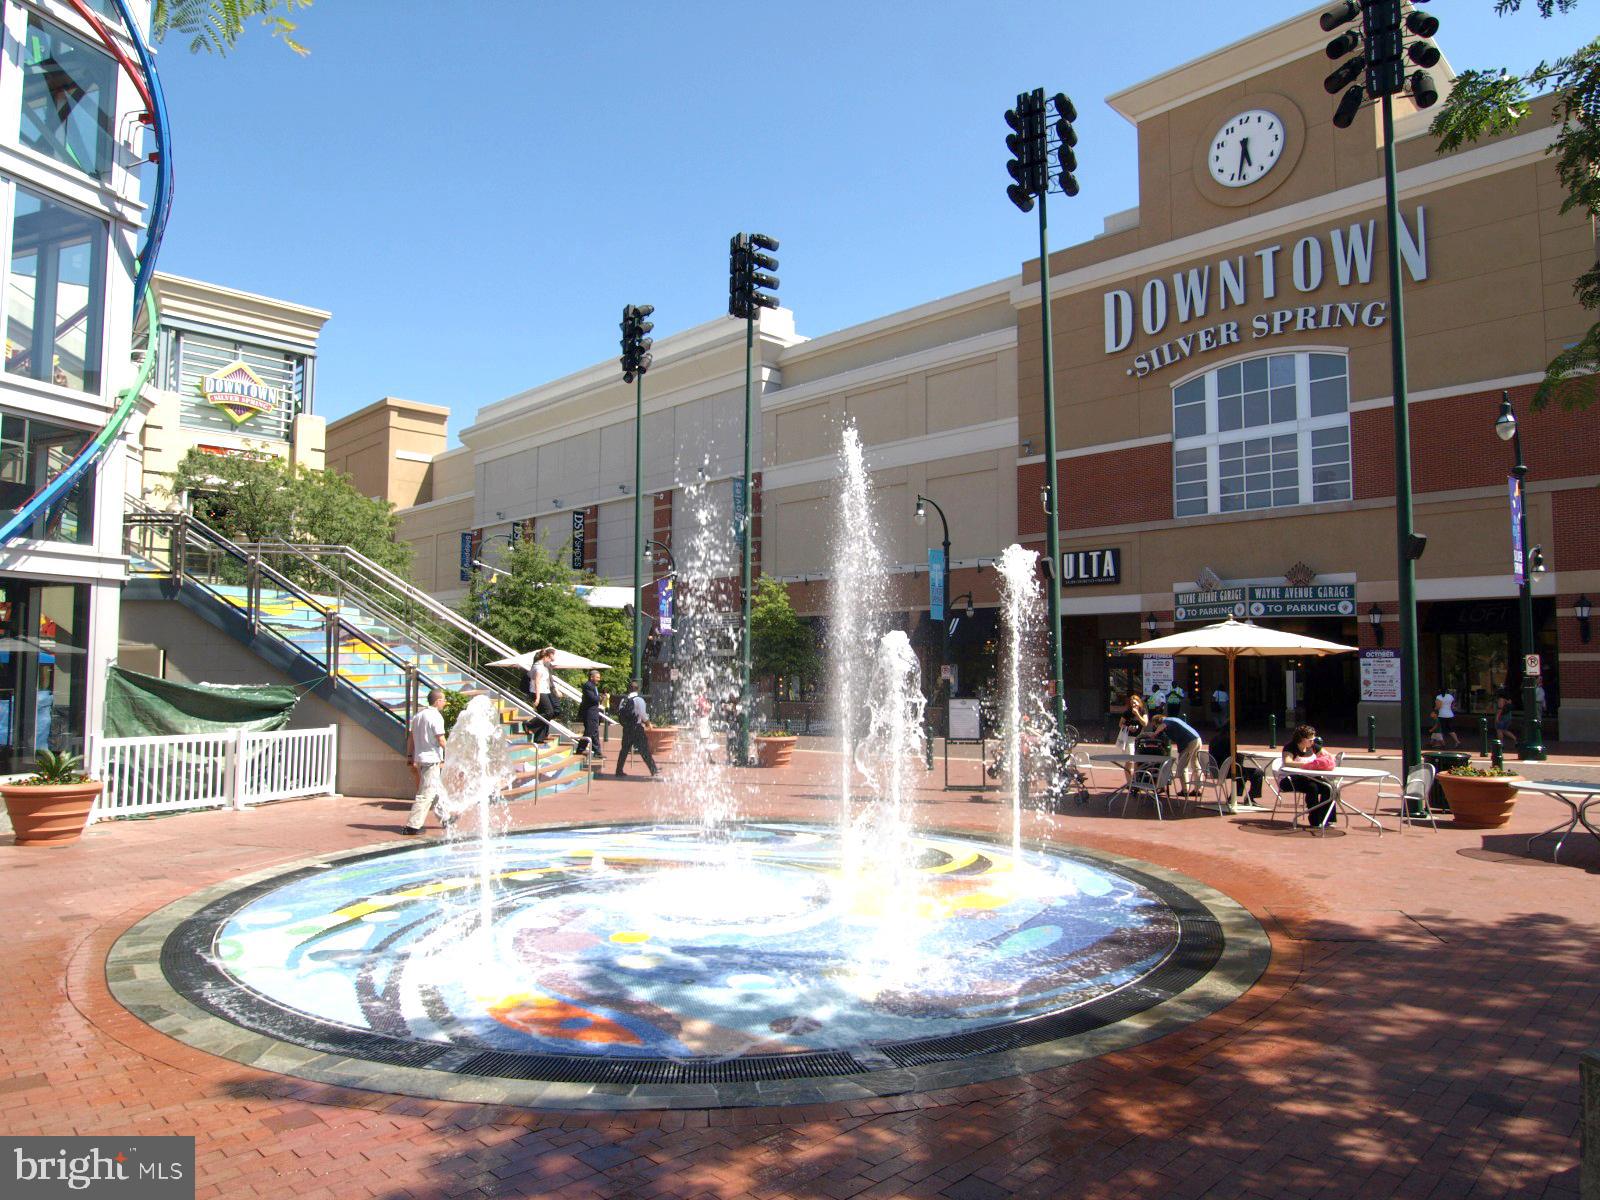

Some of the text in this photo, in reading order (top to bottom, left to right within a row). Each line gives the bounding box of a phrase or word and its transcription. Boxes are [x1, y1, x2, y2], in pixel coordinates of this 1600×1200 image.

[1103, 205, 1429, 354] DOWNTOWN
[1134, 301, 1387, 378] SILVER SPRING
[205, 376, 278, 404] DOWNTOWN
[574, 514, 584, 541] DSW
[1063, 550, 1116, 580] ULTA
[1220, 589, 1242, 600] GARAGE
[1254, 585, 1349, 599] WAYNE AVENUE GARAGE
[1187, 606, 1233, 617] TO PARKING
[1266, 603, 1337, 612] TO PARKING
